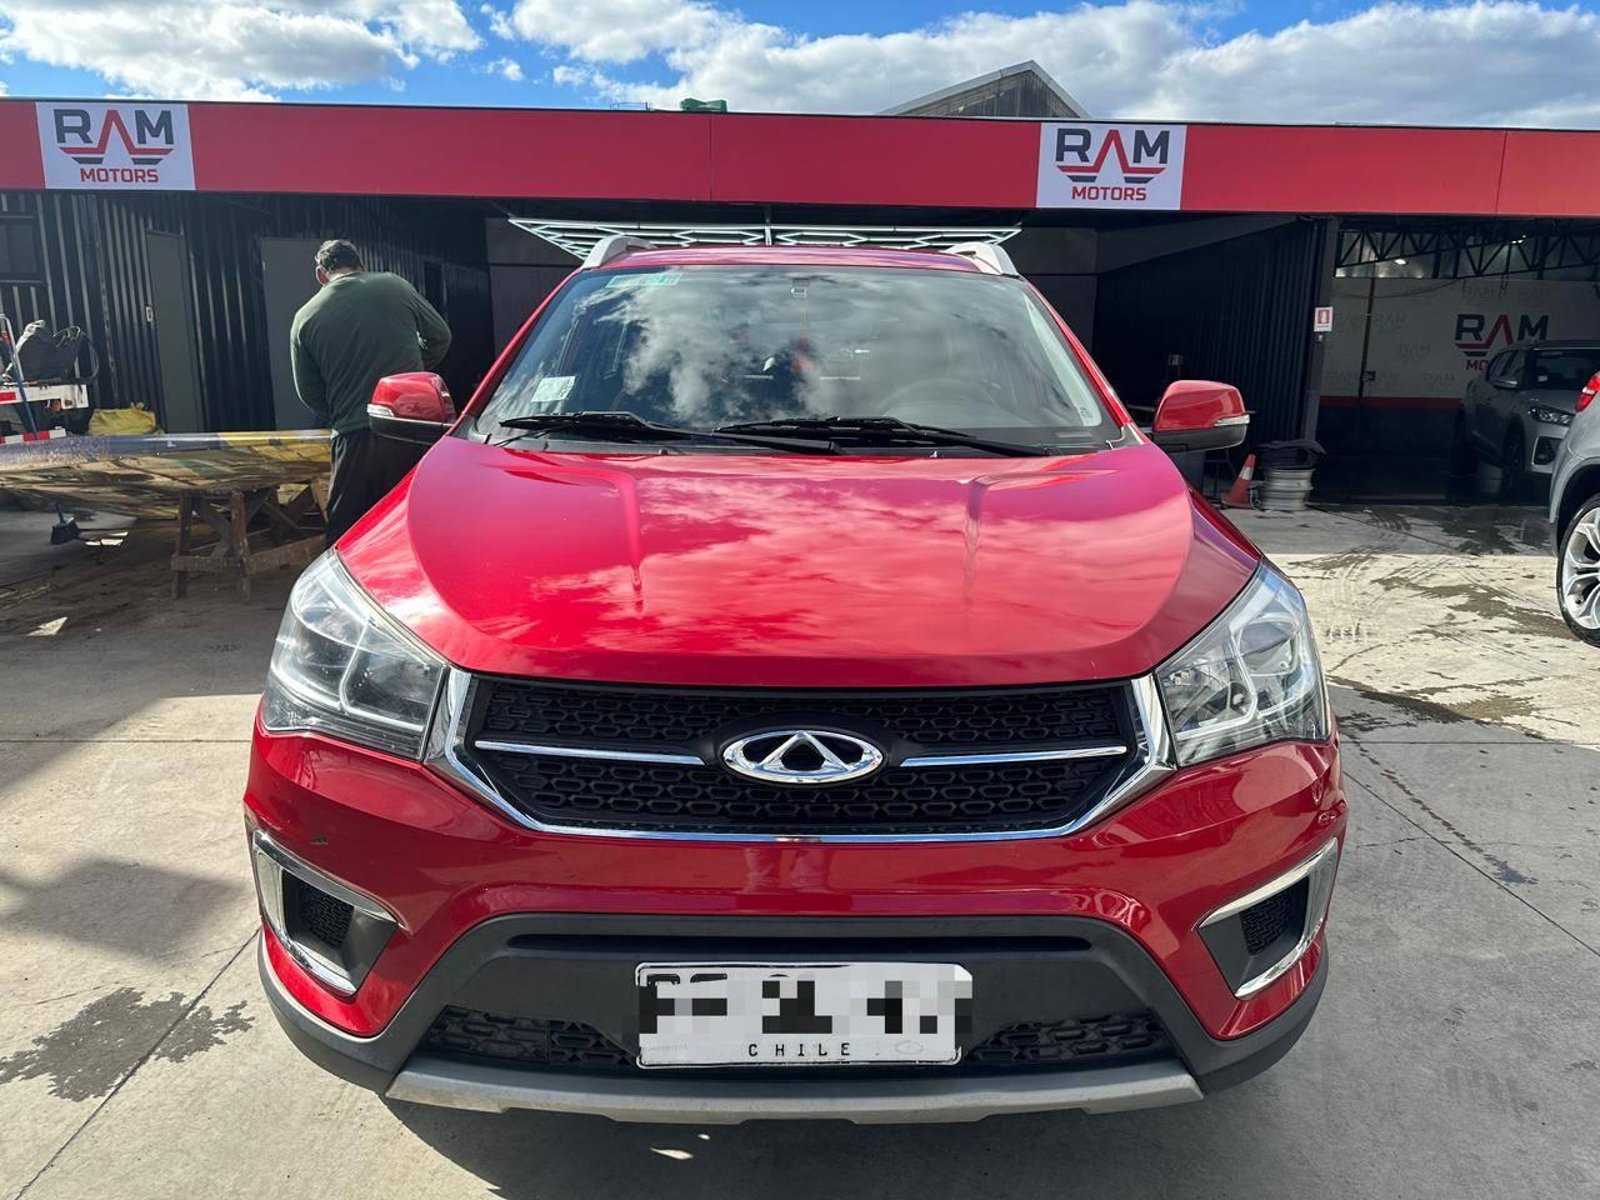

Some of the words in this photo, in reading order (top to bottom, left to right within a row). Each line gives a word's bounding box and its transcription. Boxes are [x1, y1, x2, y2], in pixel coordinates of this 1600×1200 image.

[53, 108, 175, 150] RAM
[1055, 128, 1170, 168] RAM
[80, 167, 160, 183] MOTORS
[1071, 186, 1147, 201] MOTORS
[1455, 314, 1549, 346] RAM
[748, 1043, 851, 1057] CHILE
